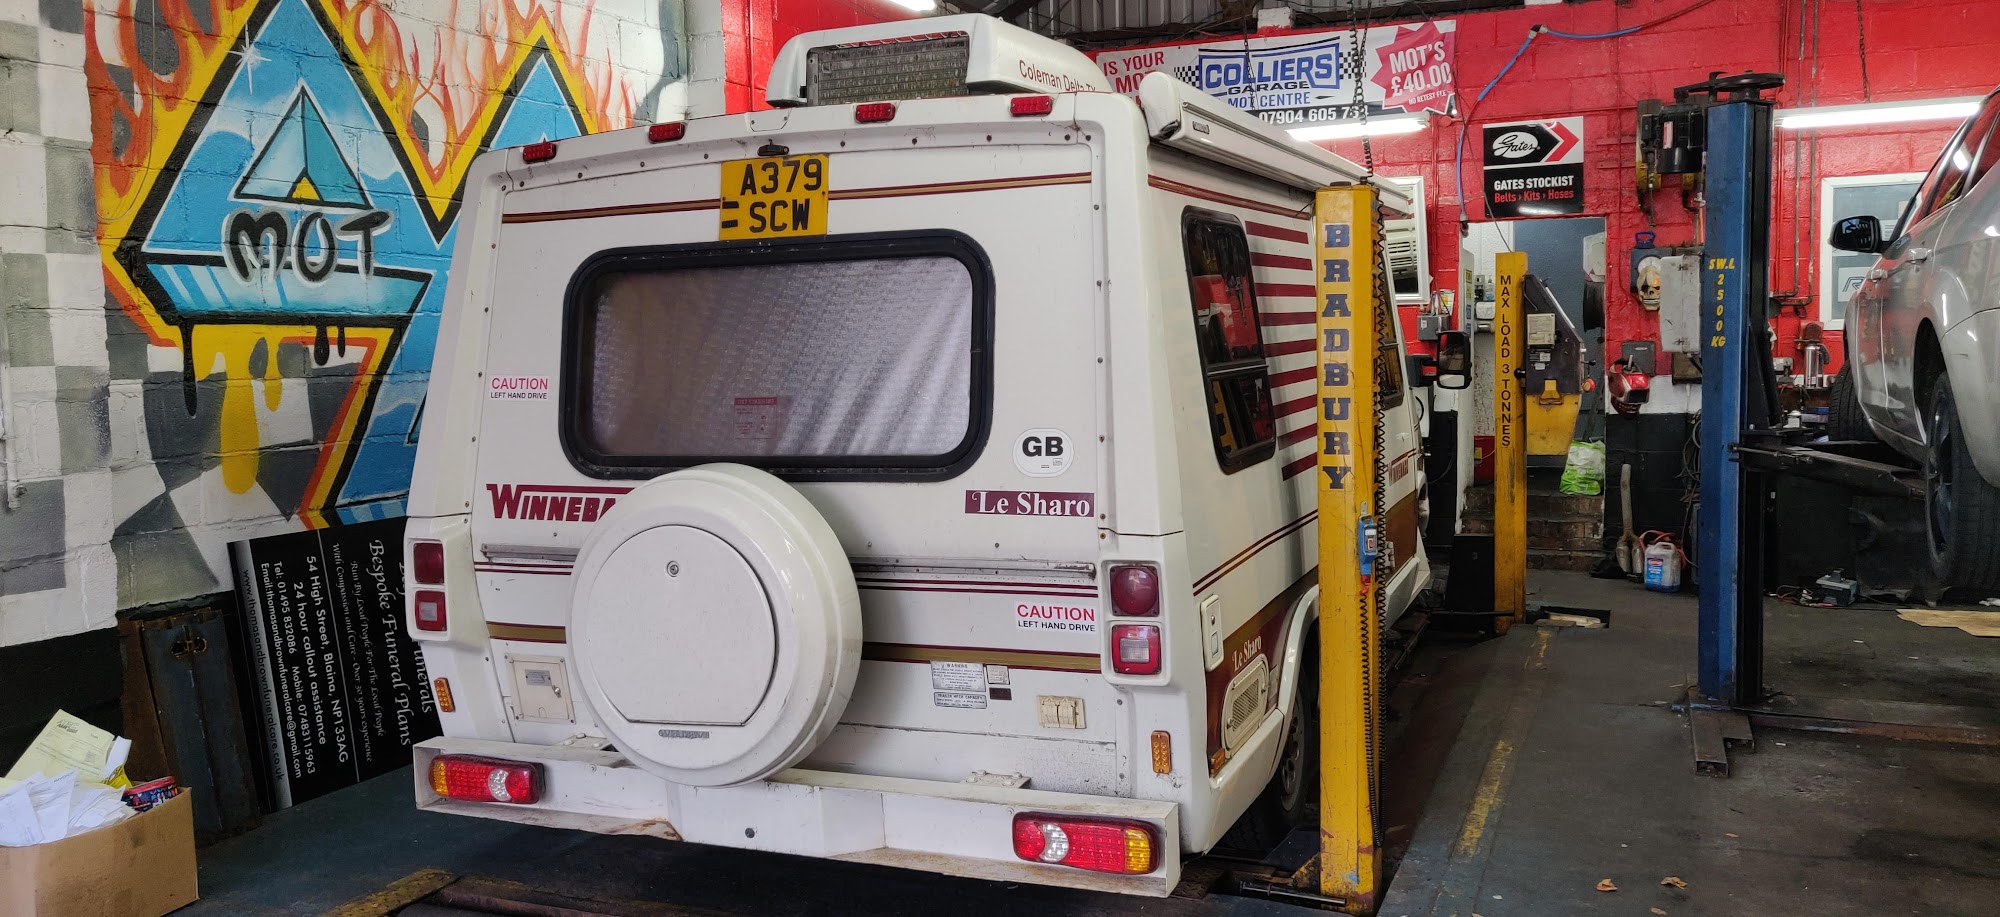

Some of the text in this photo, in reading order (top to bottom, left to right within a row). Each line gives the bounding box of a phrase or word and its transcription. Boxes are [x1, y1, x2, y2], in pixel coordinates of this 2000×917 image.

[1103, 51, 1165, 77] IS YOUR
[1389, 41, 1446, 74] MOT'S
[1019, 59, 1062, 90] Coleman
[1115, 70, 1156, 94] MO
[1205, 53, 1333, 89] COLLIERS
[1391, 62, 1452, 98] £40.00
[1228, 81, 1310, 95] GARAGE
[1228, 92, 1311, 109] MOT CENTRE
[1416, 92, 1436, 103] RETEST
[1258, 109, 1304, 125] 07904
[1308, 108, 1337, 121] 605
[1494, 134, 1536, 157] Gates
[740, 158, 822, 196] A379
[1494, 175, 1575, 191] GATES STOCKIST
[1494, 188, 1575, 204] Belts Kits Hoses
[749, 198, 811, 234] SCW
[229, 210, 391, 283] MOT
[1322, 224, 1352, 490] BRADBURY
[1500, 275, 1511, 447] MAX LOAD 3 TONNES
[490, 391, 506, 399] LEFT
[527, 392, 548, 400] DRIVE
[491, 377, 549, 390] CAUTION
[1022, 436, 1064, 458] GB
[971, 491, 1091, 517] Le Sharo
[332, 542, 345, 565] With
[335, 566, 350, 615] Compassion
[344, 616, 357, 634] and
[1017, 604, 1095, 622] CAUTION
[1018, 620, 1096, 632] LEFT HAND DRIVE
[347, 634, 357, 655] Care
[350, 561, 387, 737] Run By Local People For The Local People
[366, 540, 415, 746] Bespoke Funeral Plans
[1232, 635, 1262, 672] Le Sharo
[273, 560, 316, 774] Tel: 01495 832086 Mobile: 07483115963
[293, 581, 326, 745] 24 hour callout assistance
[306, 556, 349, 763] 54 High Street, Blaina, NP133AG
[352, 662, 361, 683] Over
[243, 569, 285, 782] www.thomasandbrownfuneralcare.co.uk
[355, 684, 363, 695] 30
[354, 696, 367, 720] years
[359, 720, 373, 762] experience
